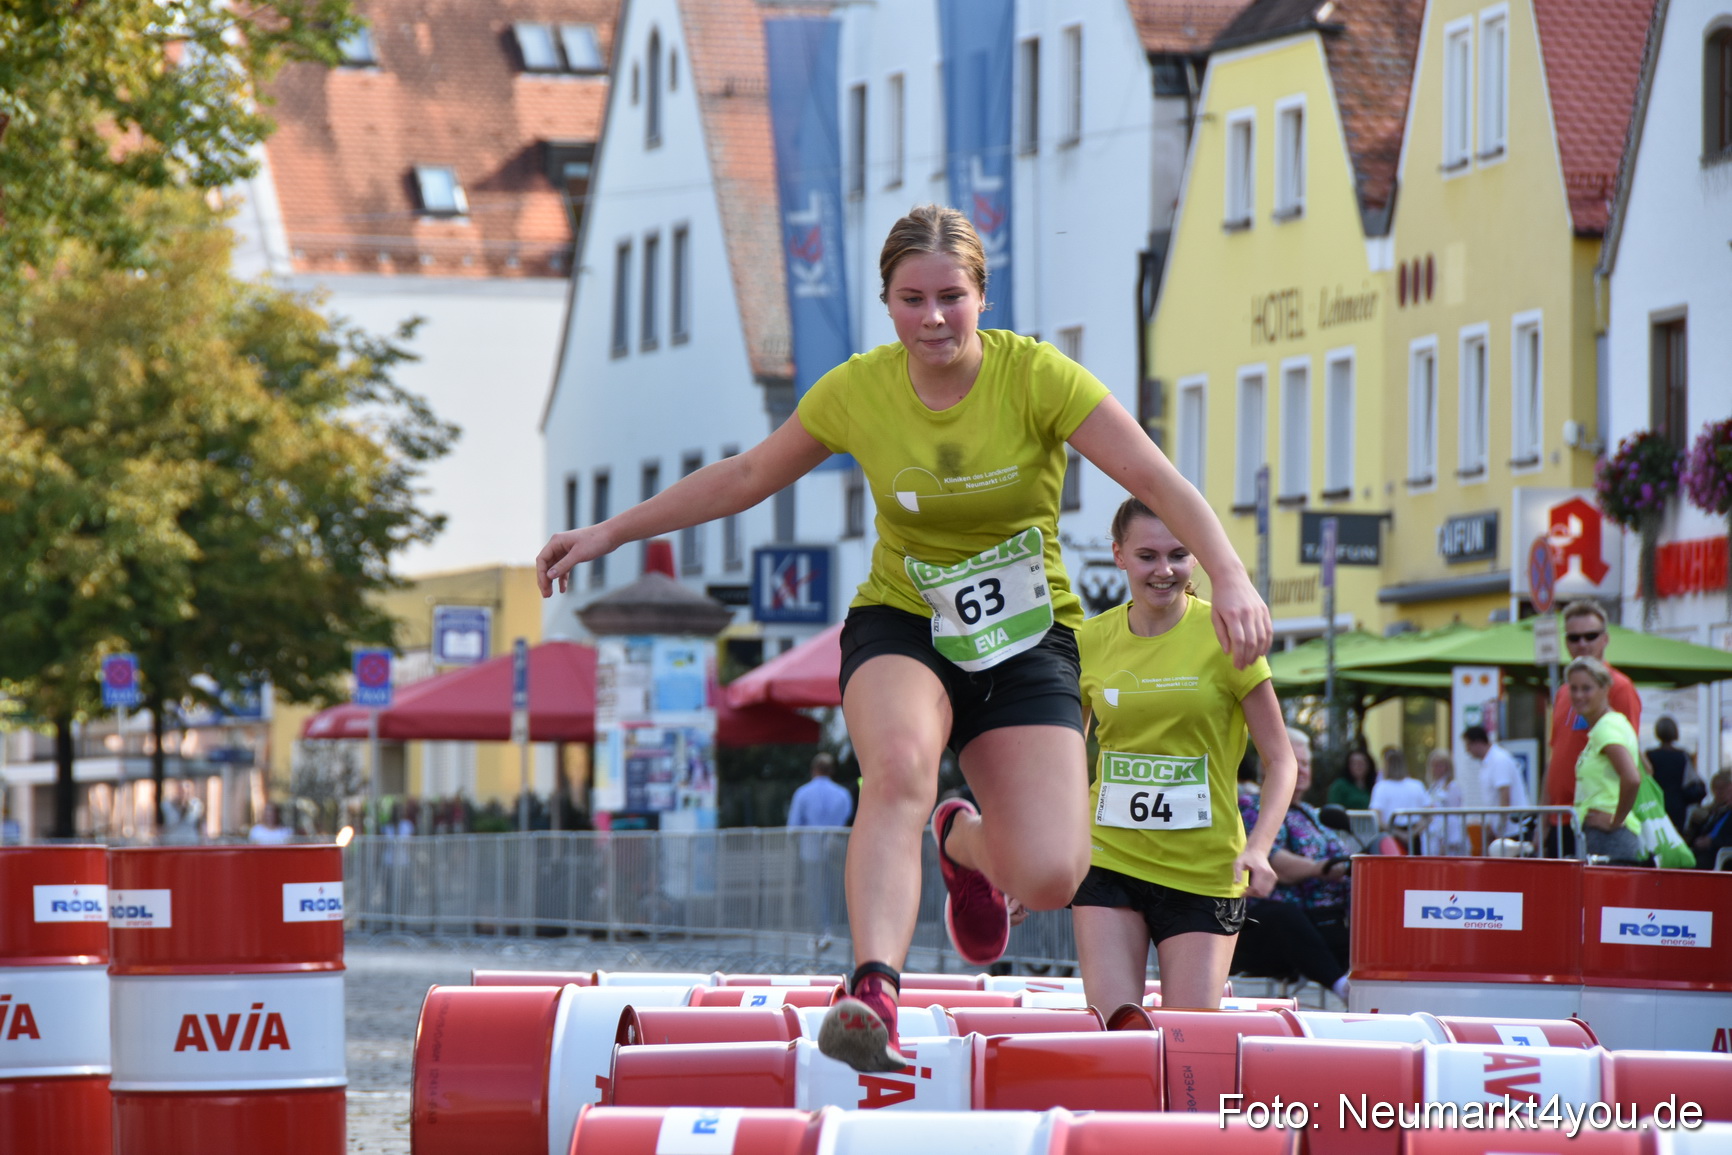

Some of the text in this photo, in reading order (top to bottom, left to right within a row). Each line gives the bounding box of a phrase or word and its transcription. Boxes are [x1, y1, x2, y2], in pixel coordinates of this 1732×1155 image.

[1250, 286, 1305, 344] HOTEL
[943, 475, 971, 484] Kliniken
[965, 478, 998, 489] Neumarkt
[954, 578, 1005, 625] 63
[973, 627, 1010, 654] EVA
[1111, 757, 1198, 783] BOCK
[1130, 791, 1173, 822] 64
